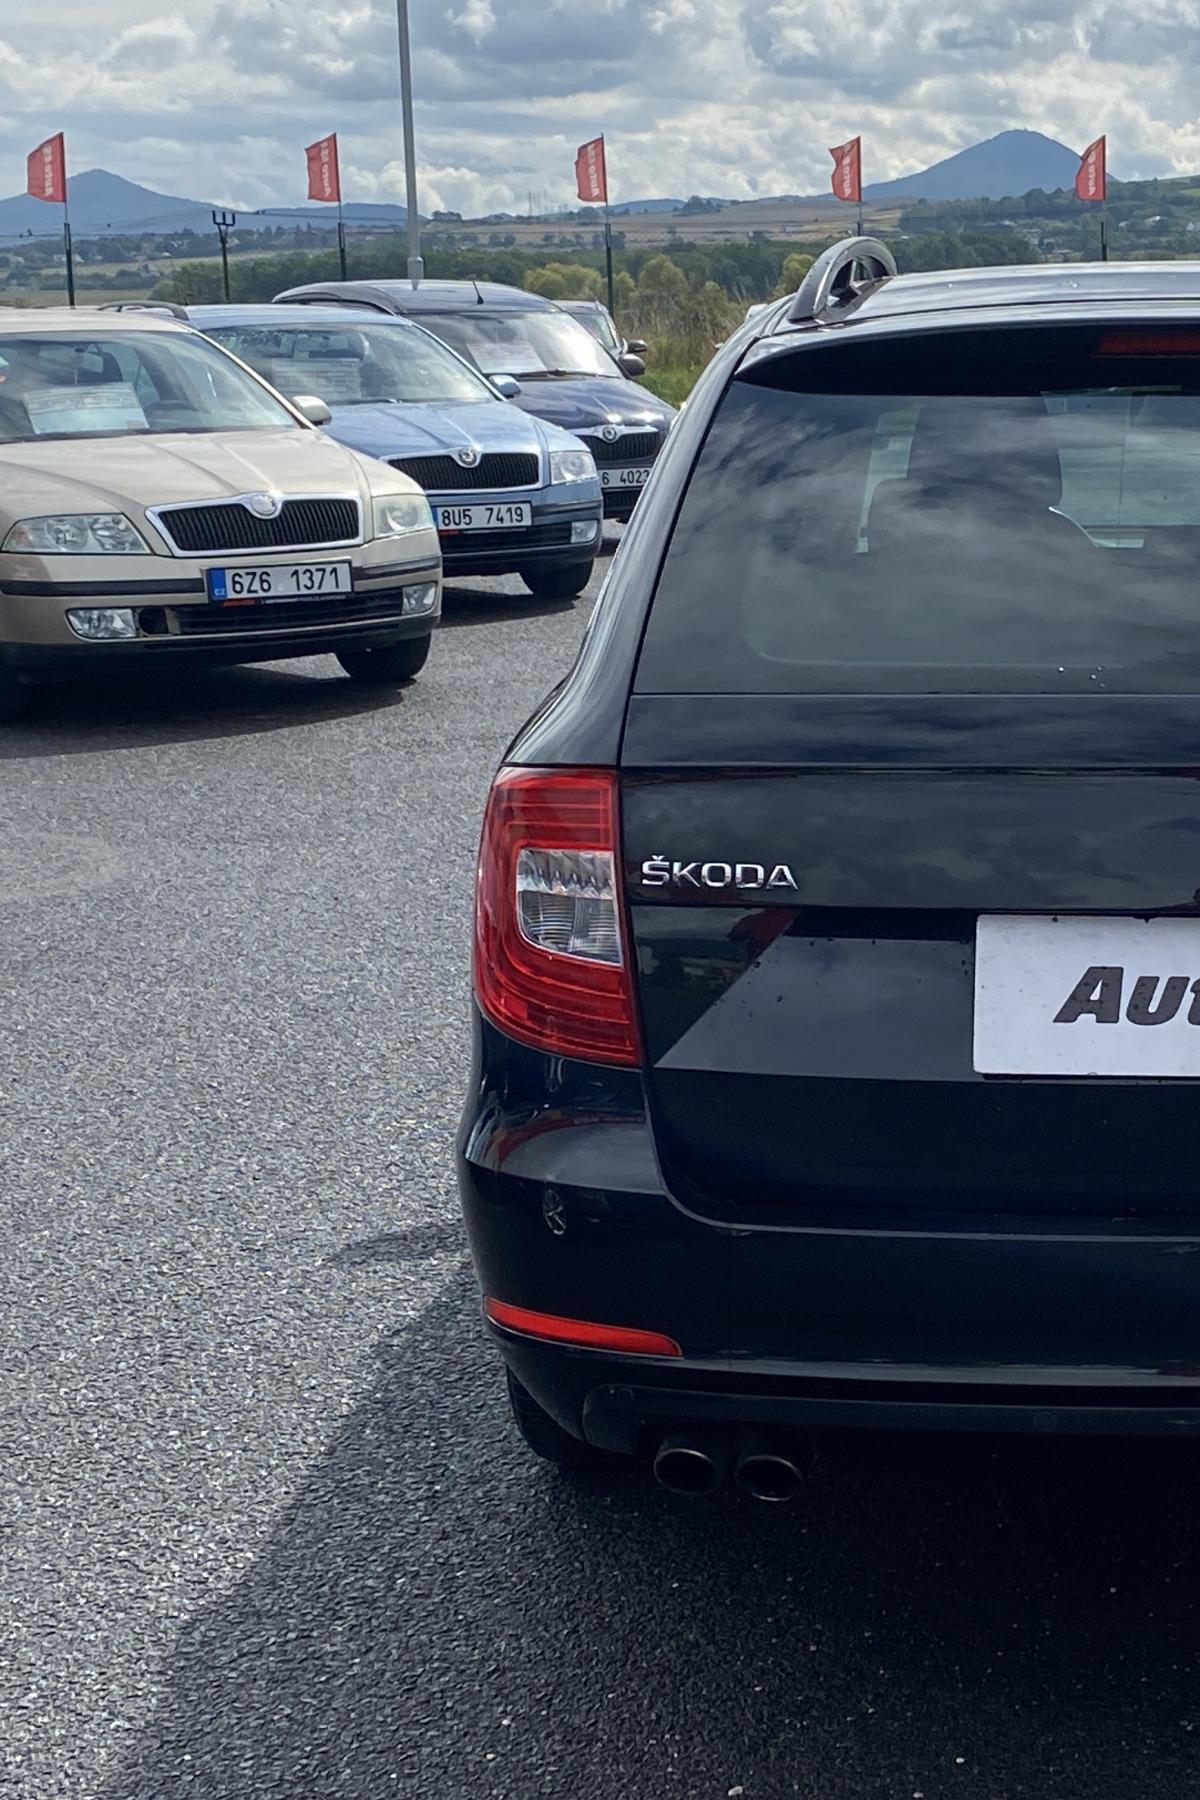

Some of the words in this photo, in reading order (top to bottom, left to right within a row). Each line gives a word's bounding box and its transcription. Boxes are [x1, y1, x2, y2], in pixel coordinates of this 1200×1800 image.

[441, 511, 473, 527] 8U5
[485, 506, 524, 524] 7419
[231, 571, 272, 594] 6Z6
[290, 567, 340, 592] 1371
[641, 855, 799, 890] ŠKODA
